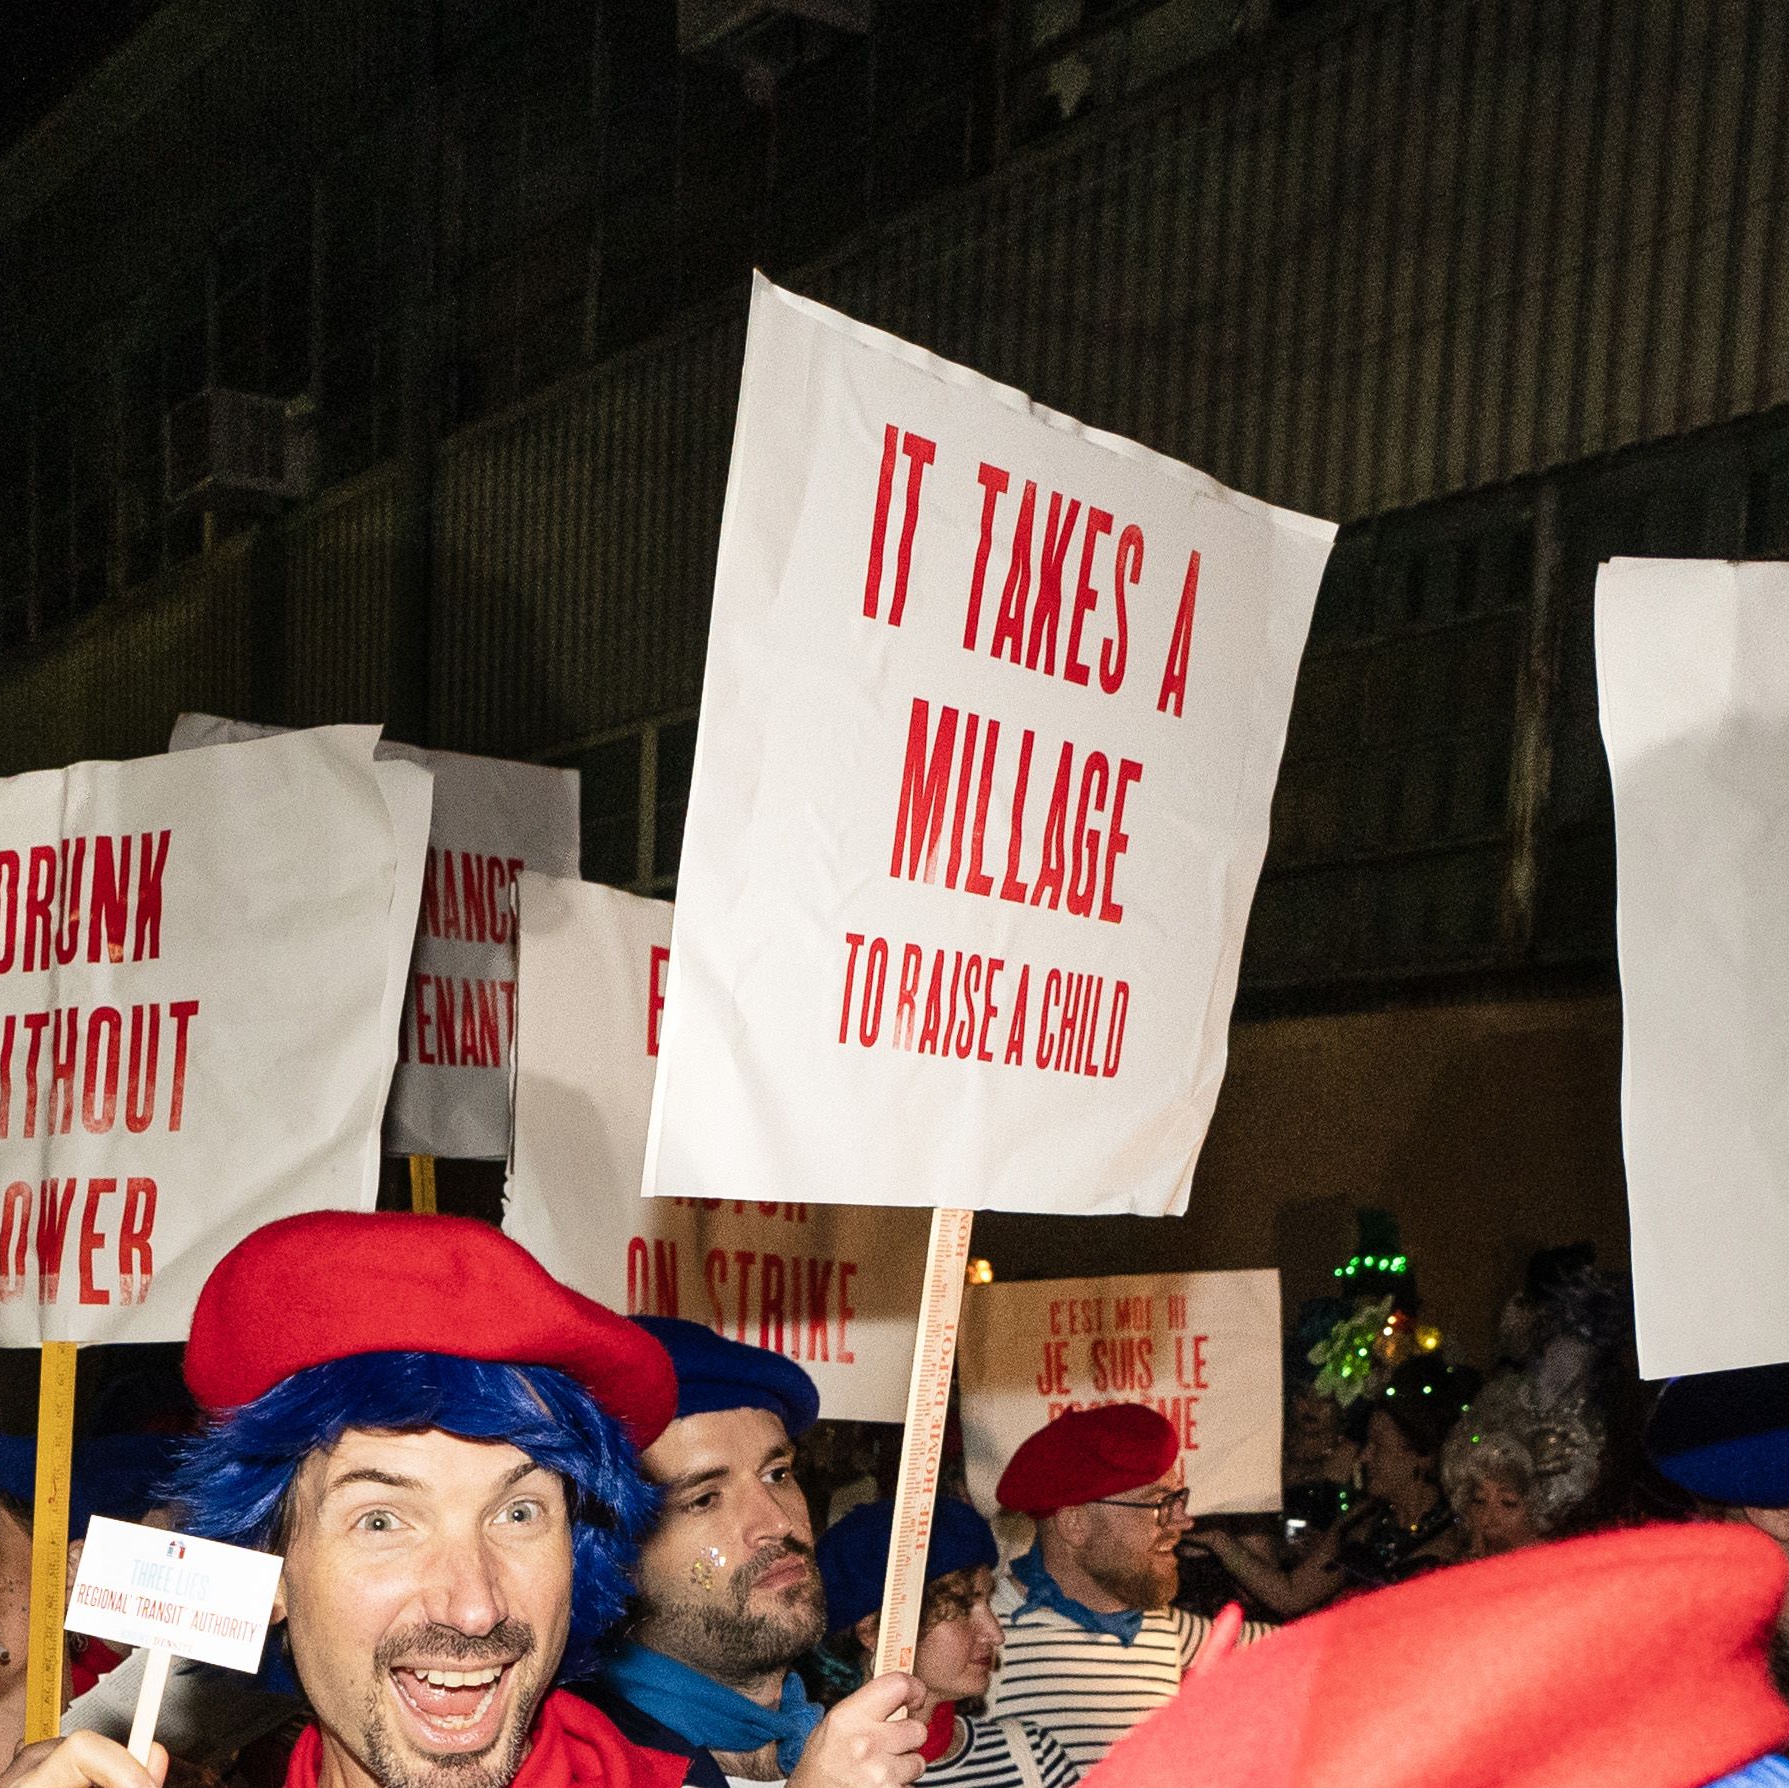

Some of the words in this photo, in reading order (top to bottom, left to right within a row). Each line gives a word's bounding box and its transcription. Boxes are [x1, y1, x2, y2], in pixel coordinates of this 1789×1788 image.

[863, 423, 937, 627] IT
[963, 459, 1144, 696] TAKES
[1157, 550, 1201, 719] A
[889, 697, 1143, 924] MILLAGE
[839, 933, 887, 1049] TO
[893, 943, 1004, 1064] RAISE
[1005, 963, 1033, 1067] A
[1035, 967, 1129, 1080] CHILD
[628, 1237, 678, 1317] ON
[704, 1248, 857, 1364] STRIKE
[1035, 1340, 1070, 1395] JE
[1091, 1338, 1153, 1391] SUIS
[1175, 1335, 1209, 1389] LE
[1114, 1296, 1152, 1332] MOI
[922, 1415, 943, 1494] HOME
[935, 1323, 955, 1406] DEPOT
